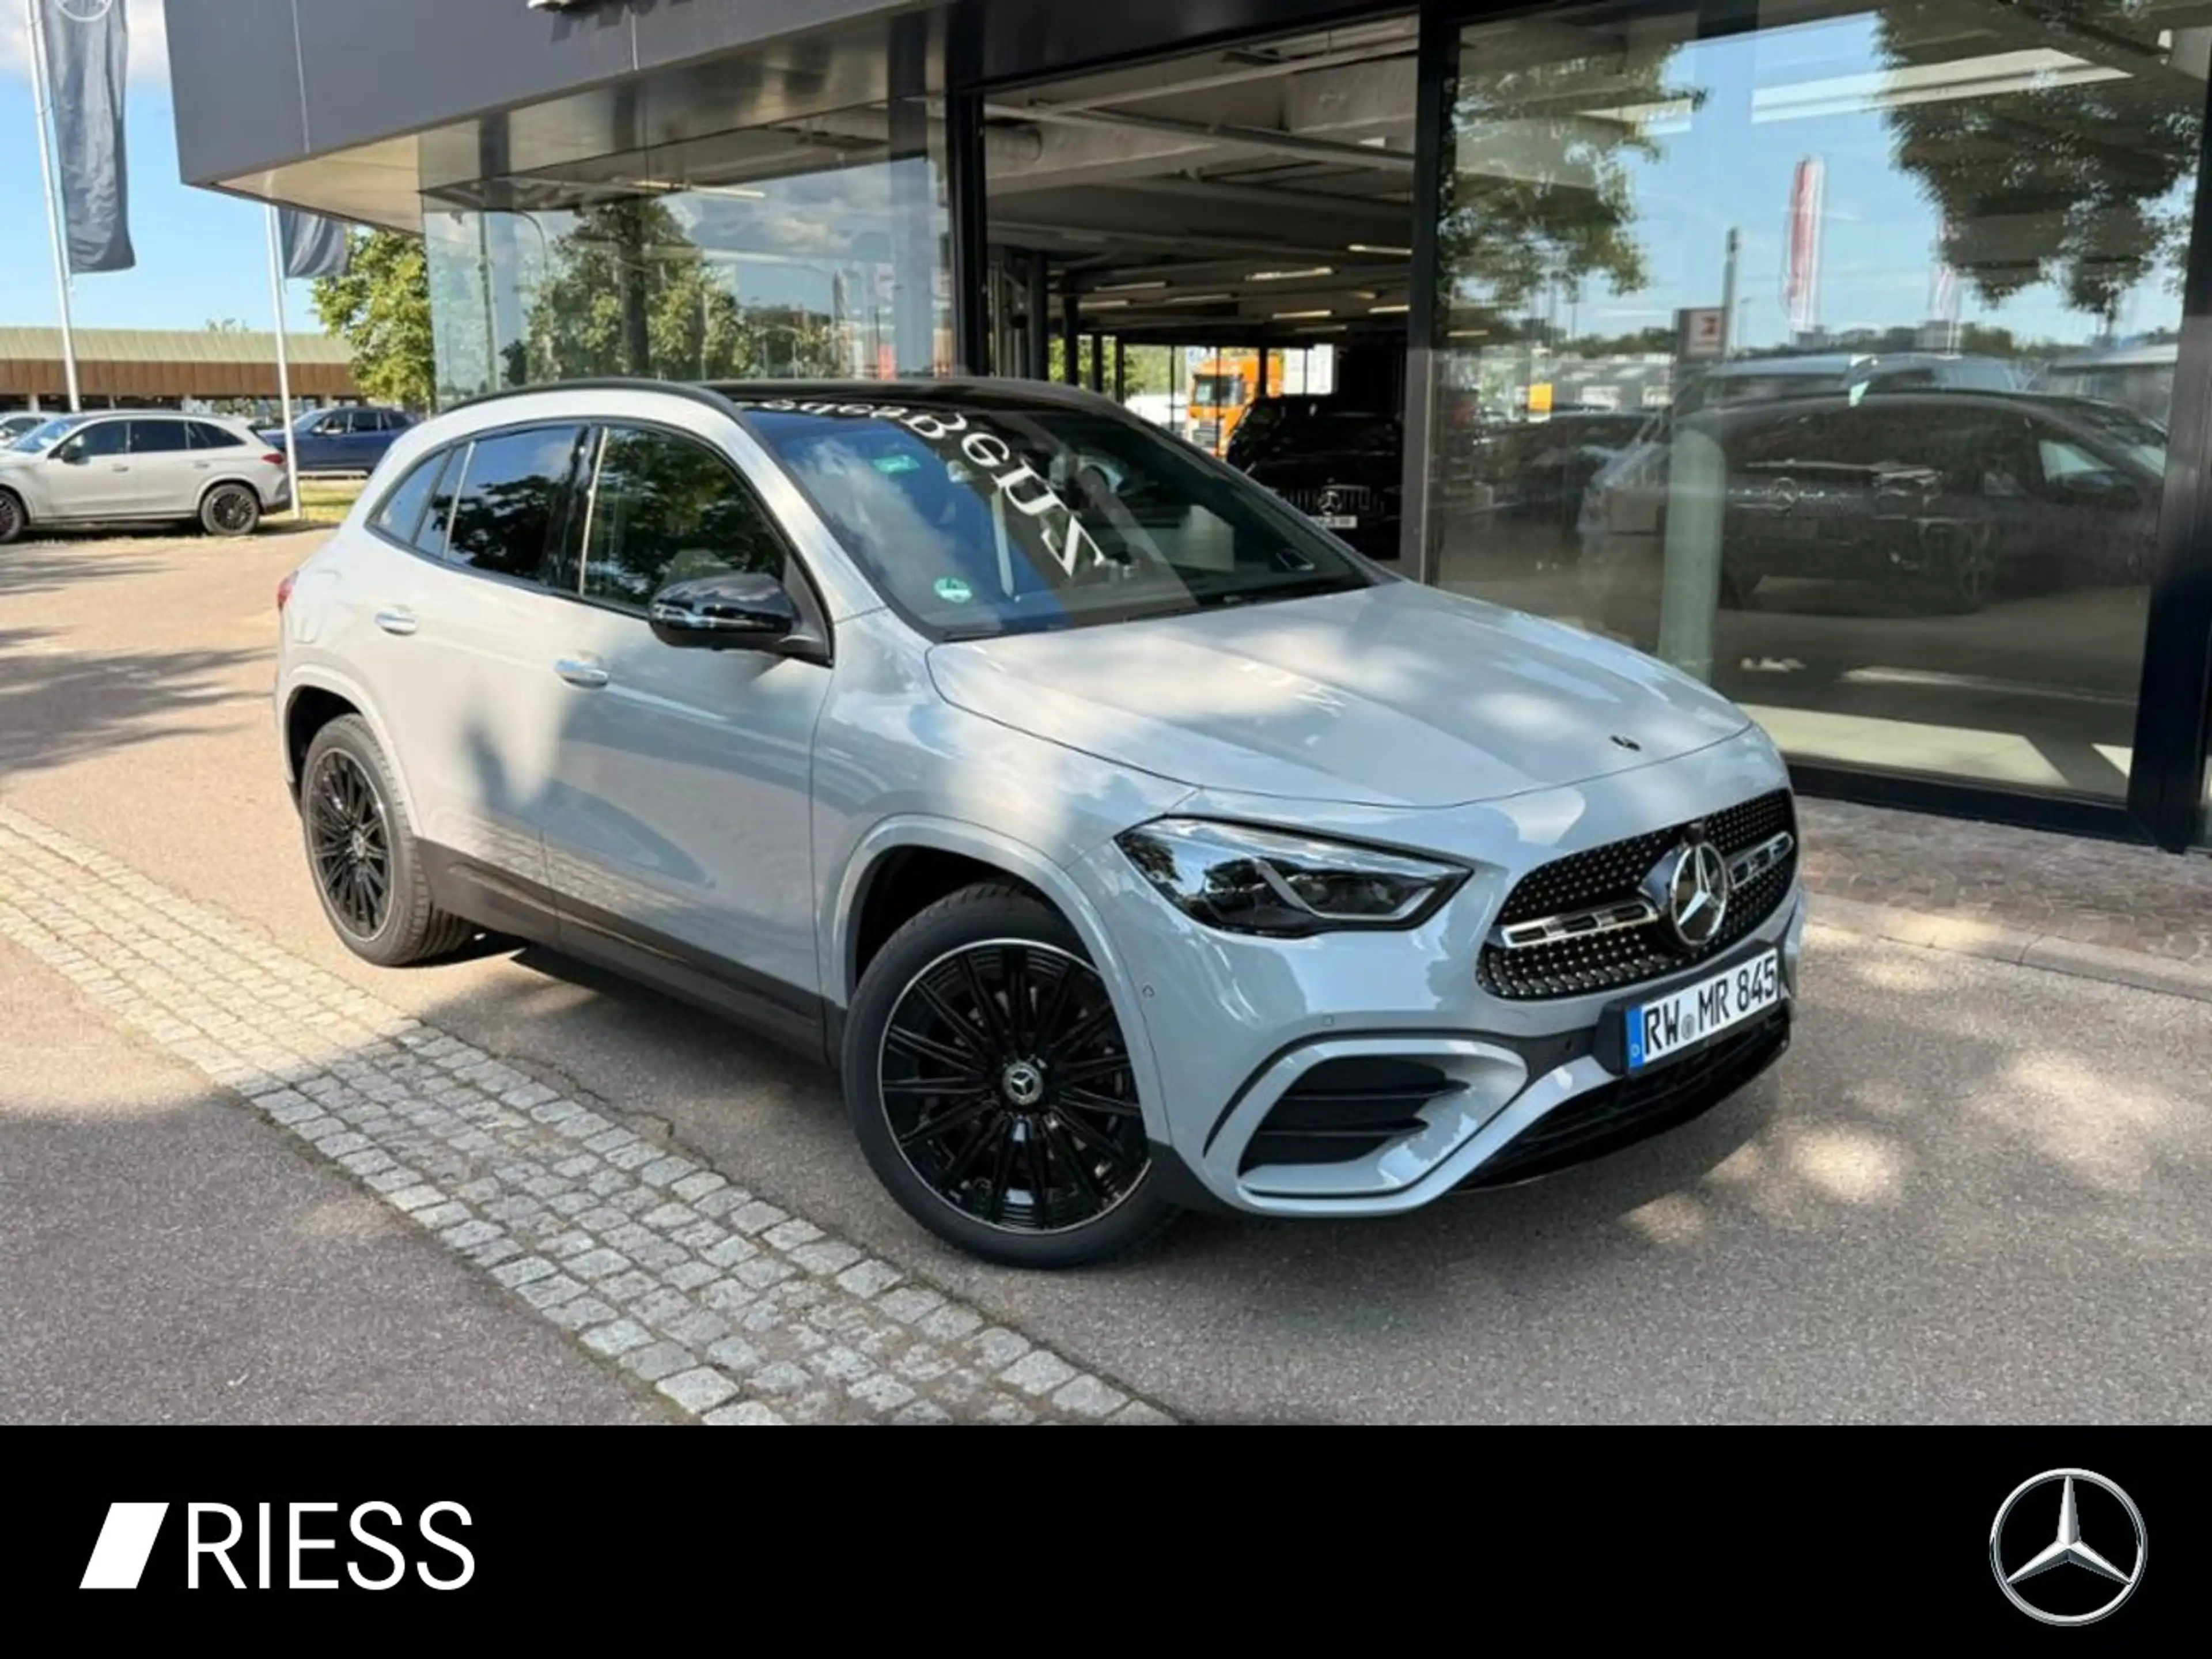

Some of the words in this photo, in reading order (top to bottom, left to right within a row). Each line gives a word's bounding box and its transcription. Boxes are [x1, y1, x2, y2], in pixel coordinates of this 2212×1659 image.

[1643, 999, 1680, 1055] RW
[1699, 979, 1729, 1033] MR
[1736, 956, 1776, 1013] 845
